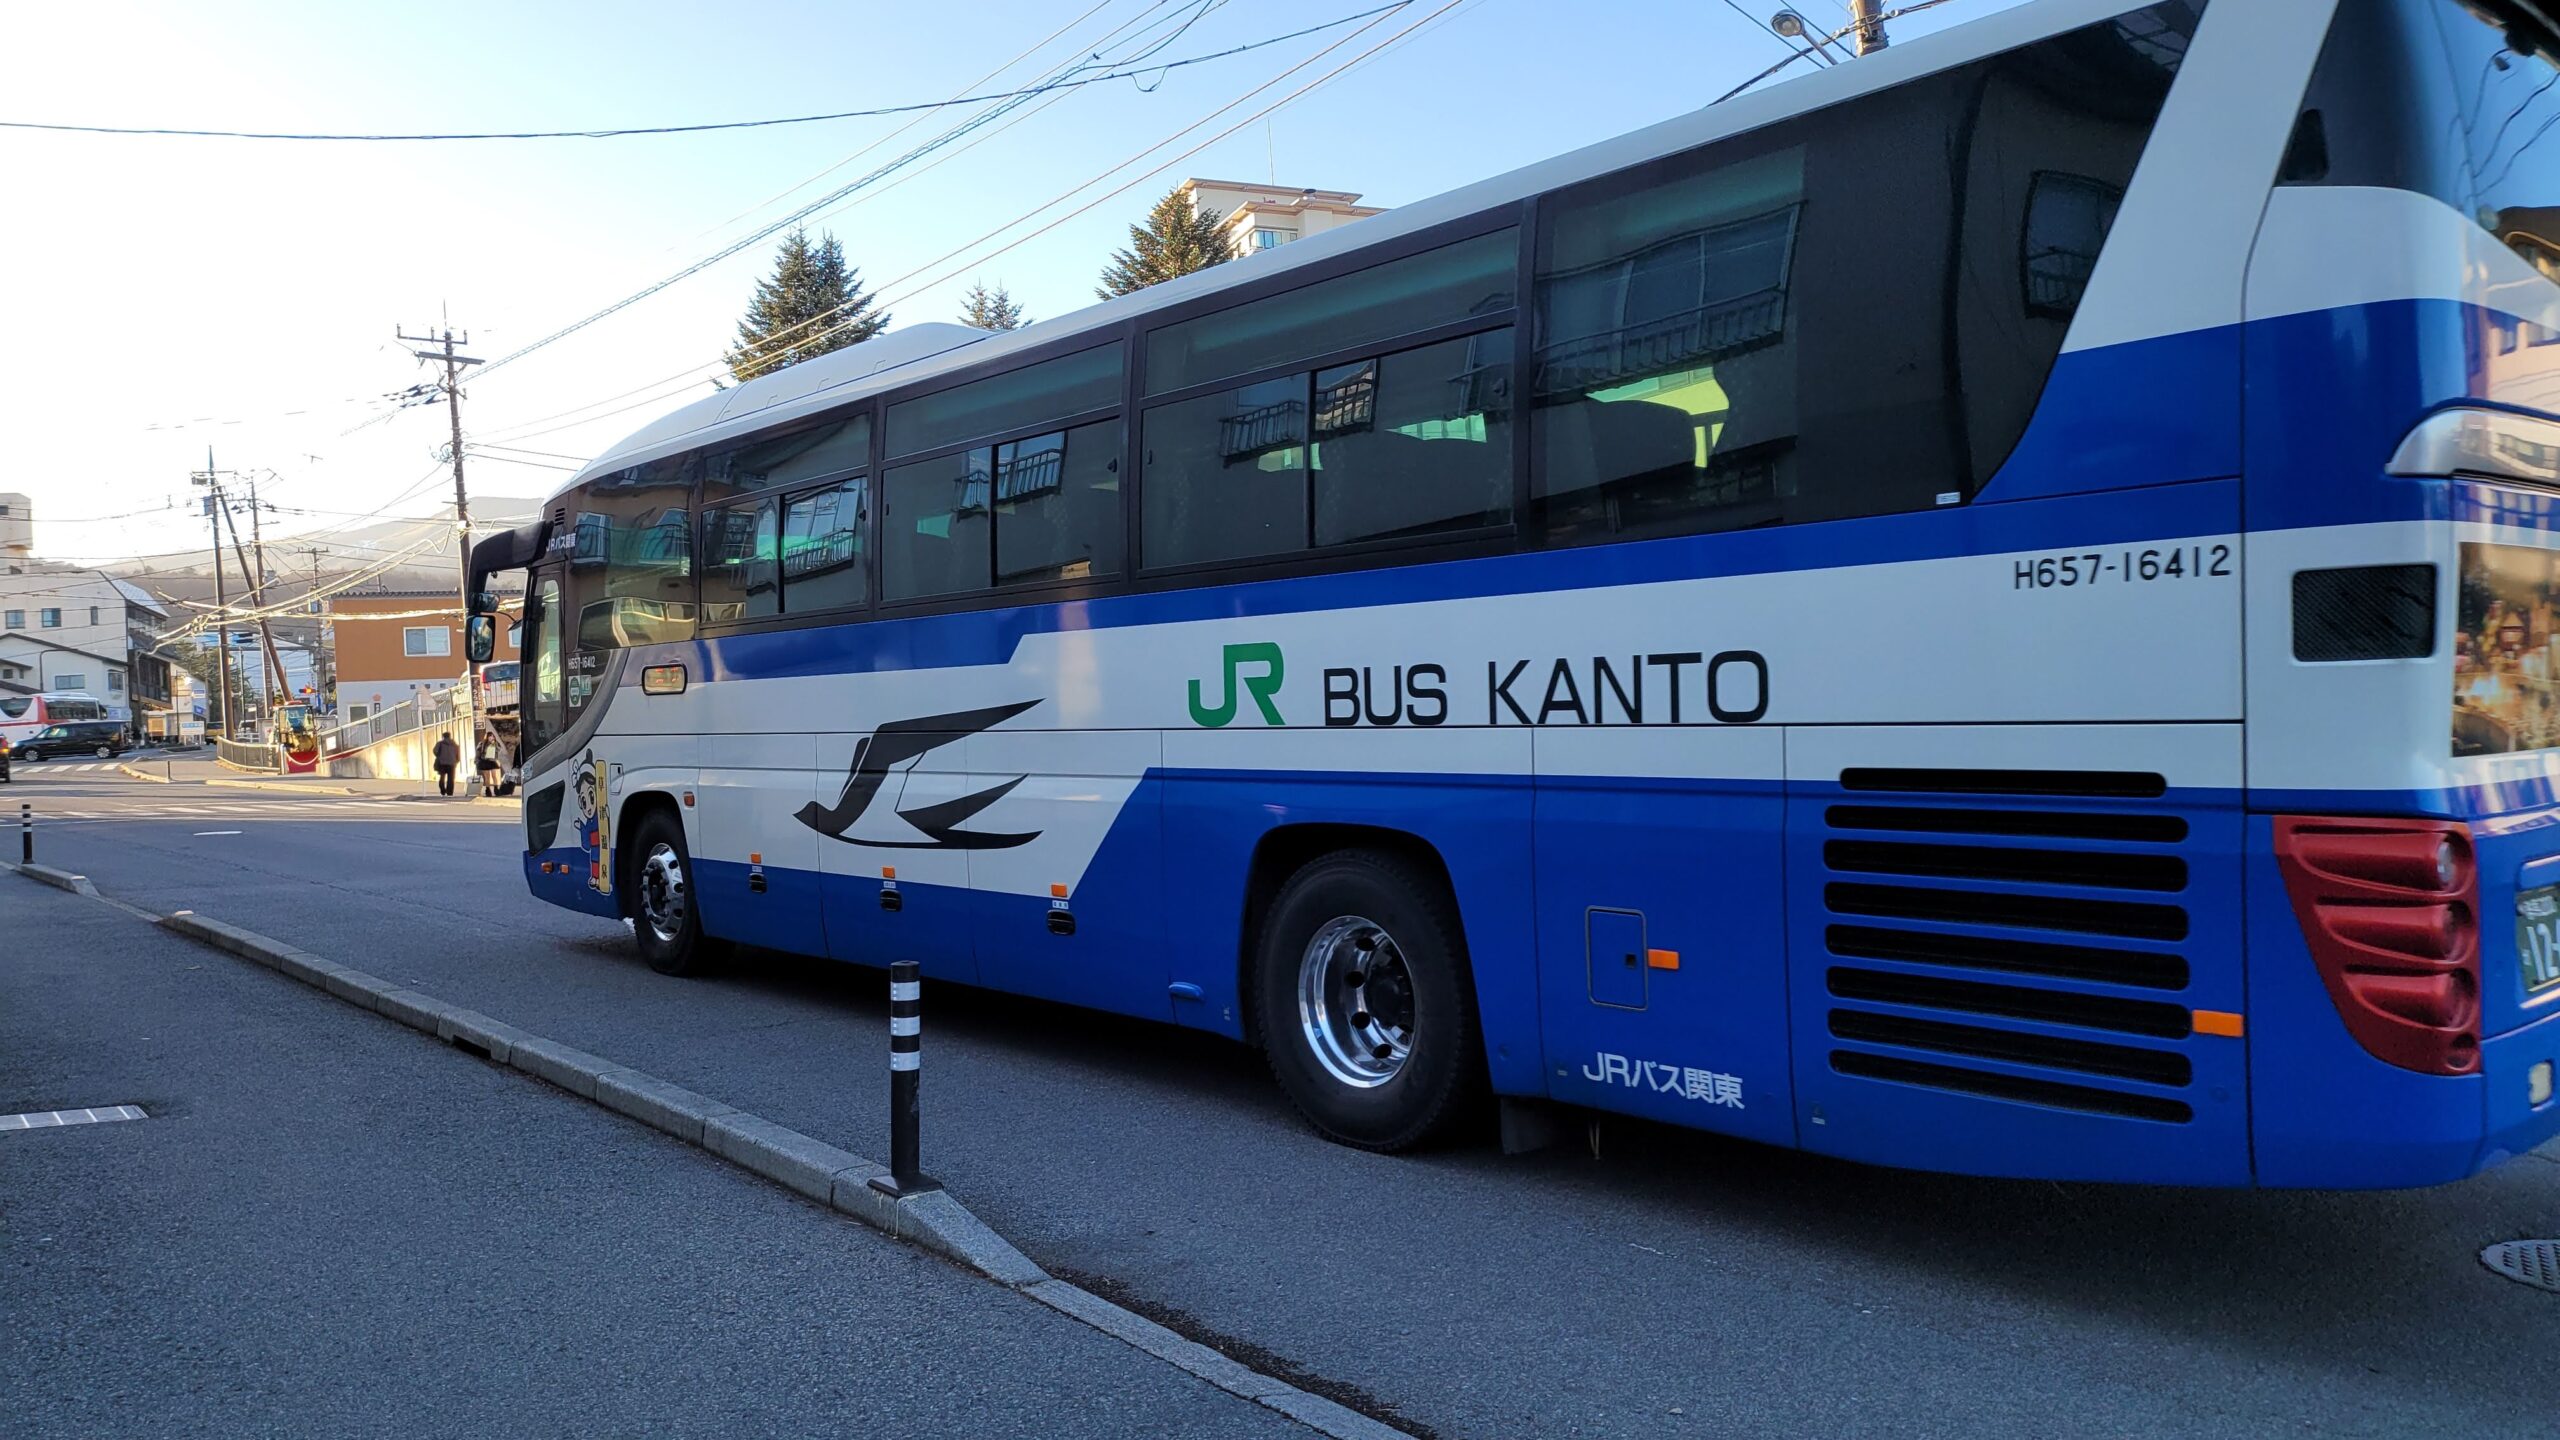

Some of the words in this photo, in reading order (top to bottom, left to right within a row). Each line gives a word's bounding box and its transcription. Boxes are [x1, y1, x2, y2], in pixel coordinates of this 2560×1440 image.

[2014, 544, 2232, 590] H657-16412
[1188, 641, 1286, 728] JR
[1323, 663, 1448, 727] BUS
[1488, 649, 1771, 725] KANTO
[598, 776, 608, 880] 草津温泉
[1582, 1052, 1745, 1110] JRバス関東
